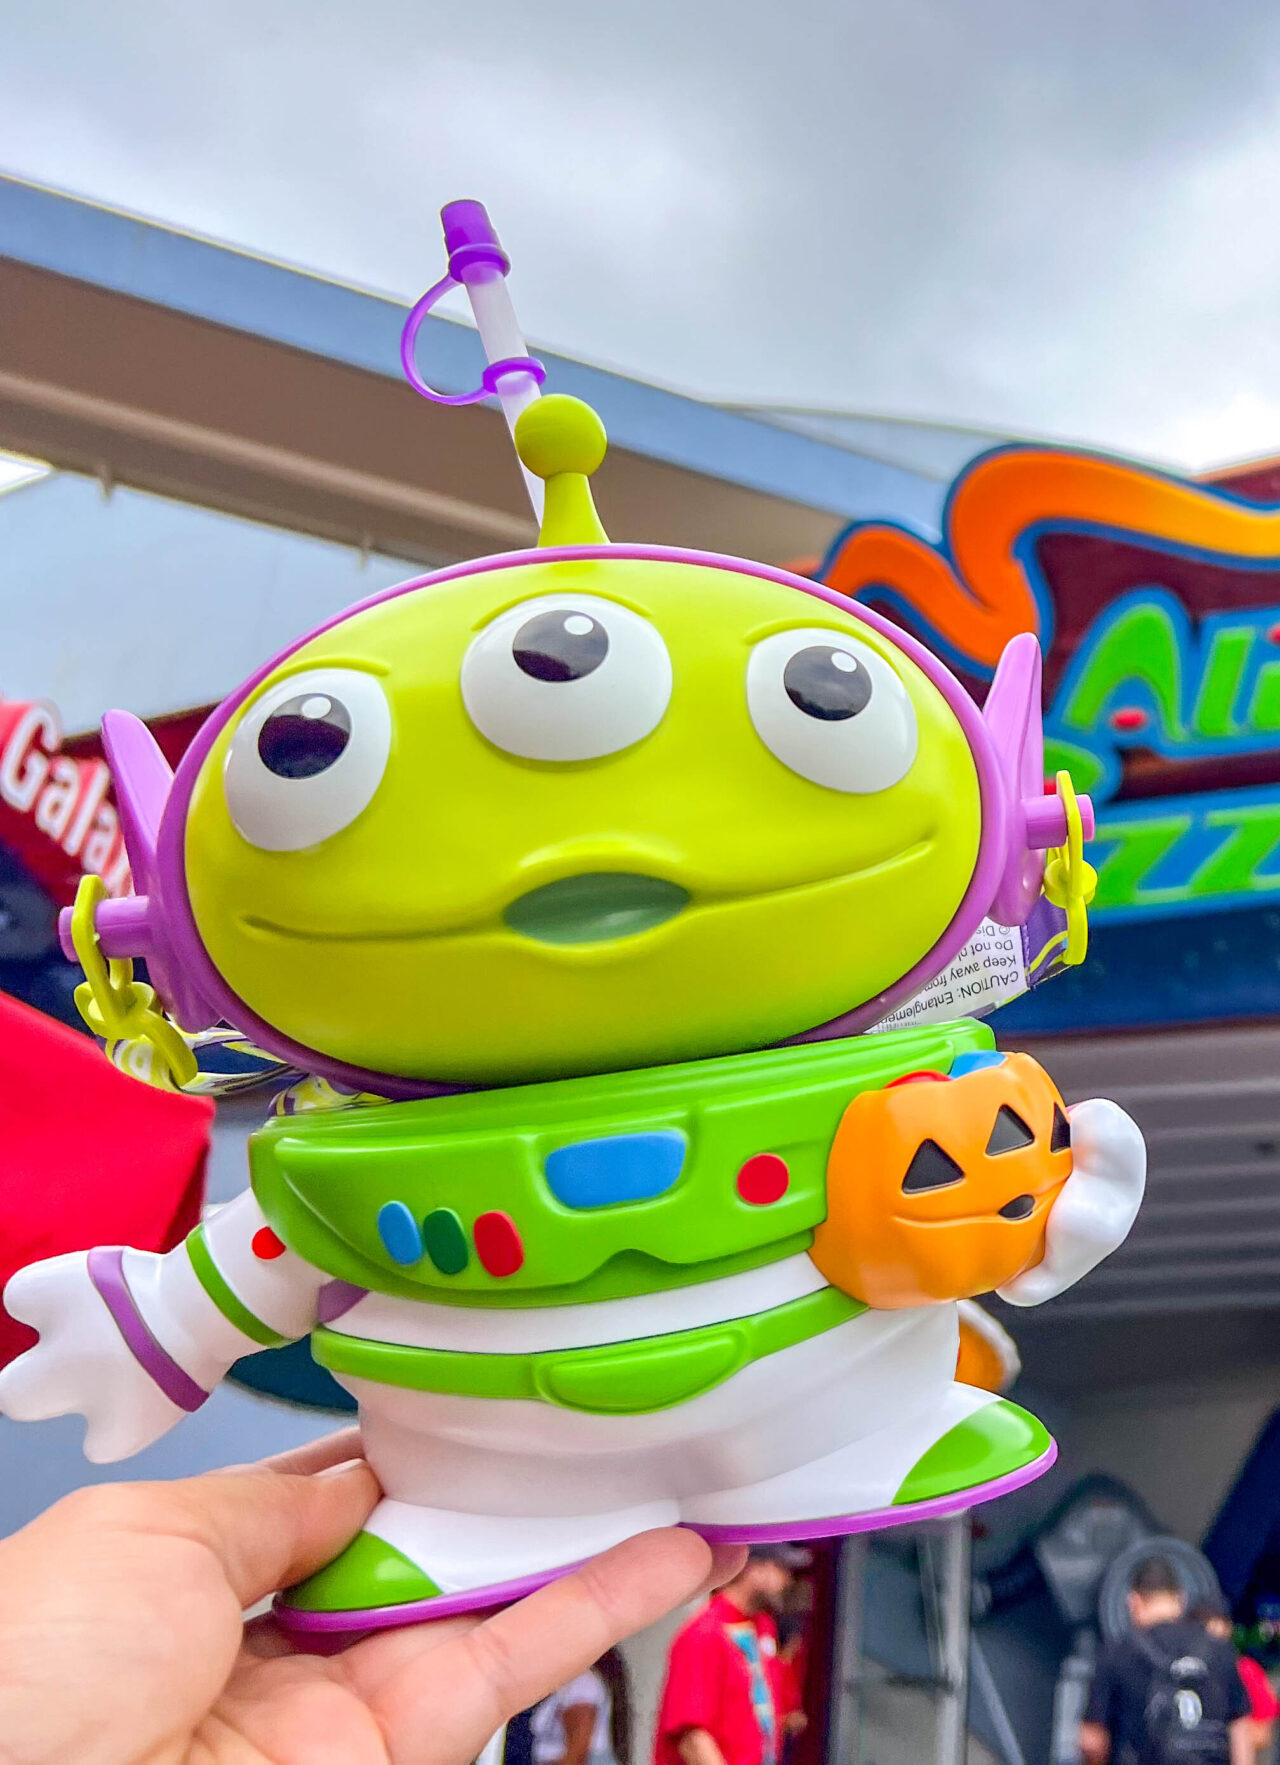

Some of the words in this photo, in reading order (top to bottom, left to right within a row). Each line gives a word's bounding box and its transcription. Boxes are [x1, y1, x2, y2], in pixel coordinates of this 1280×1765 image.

[970, 942, 991, 956] not
[995, 939, 1013, 952] Do
[983, 955, 1016, 969] Keep
[950, 962, 979, 981] away
[957, 970, 1019, 999] CAUTION:
